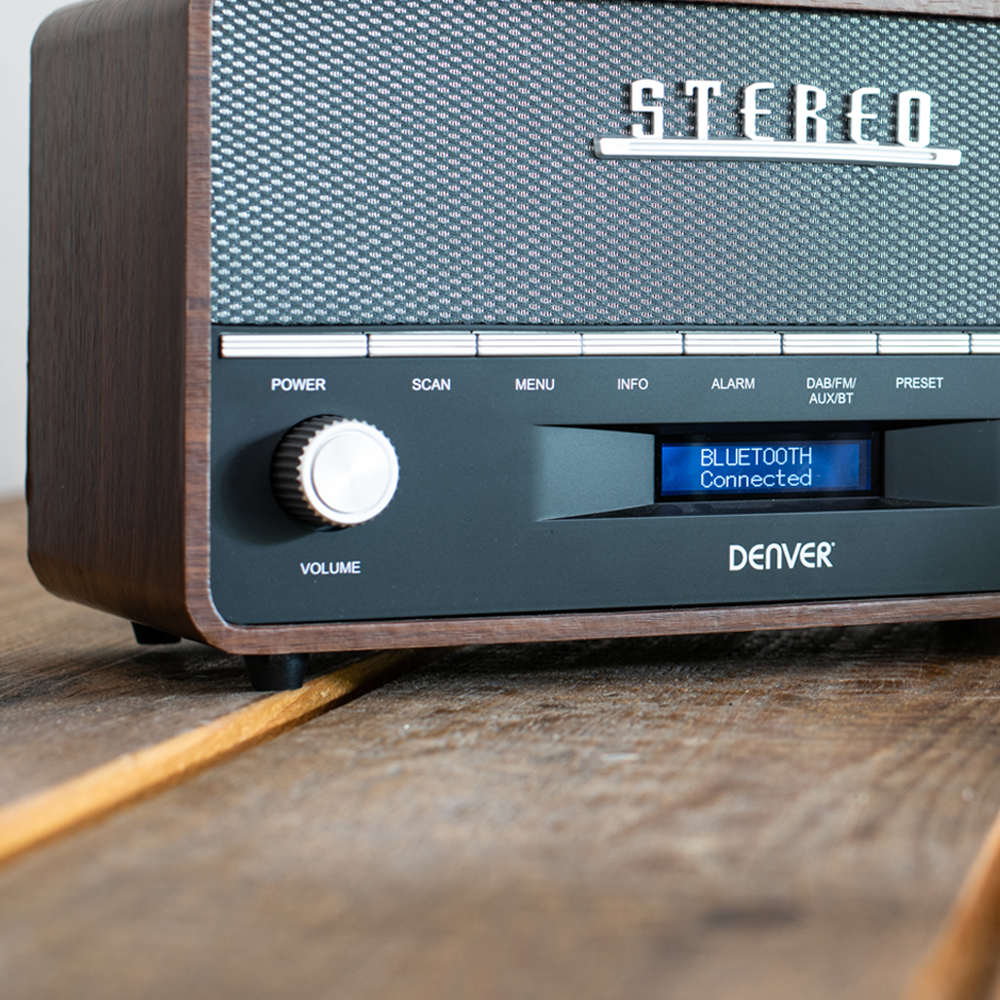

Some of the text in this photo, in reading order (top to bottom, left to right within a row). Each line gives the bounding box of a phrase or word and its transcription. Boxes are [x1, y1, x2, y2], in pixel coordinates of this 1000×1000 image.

[630, 78, 933, 147] STEREO
[271, 377, 327, 392] POWER
[411, 377, 451, 391] SCAN
[515, 377, 555, 391] MENU
[617, 377, 649, 391] INFO
[710, 377, 756, 390] ALARM
[806, 377, 857, 390] DAB/FM/
[895, 376, 944, 389] PRESET
[808, 392, 854, 405] AUX/BT
[700, 446, 812, 467] BLUETOOTH
[700, 468, 812, 489] Connected
[728, 541, 836, 572] DENVER
[299, 560, 361, 576] VOLUME
